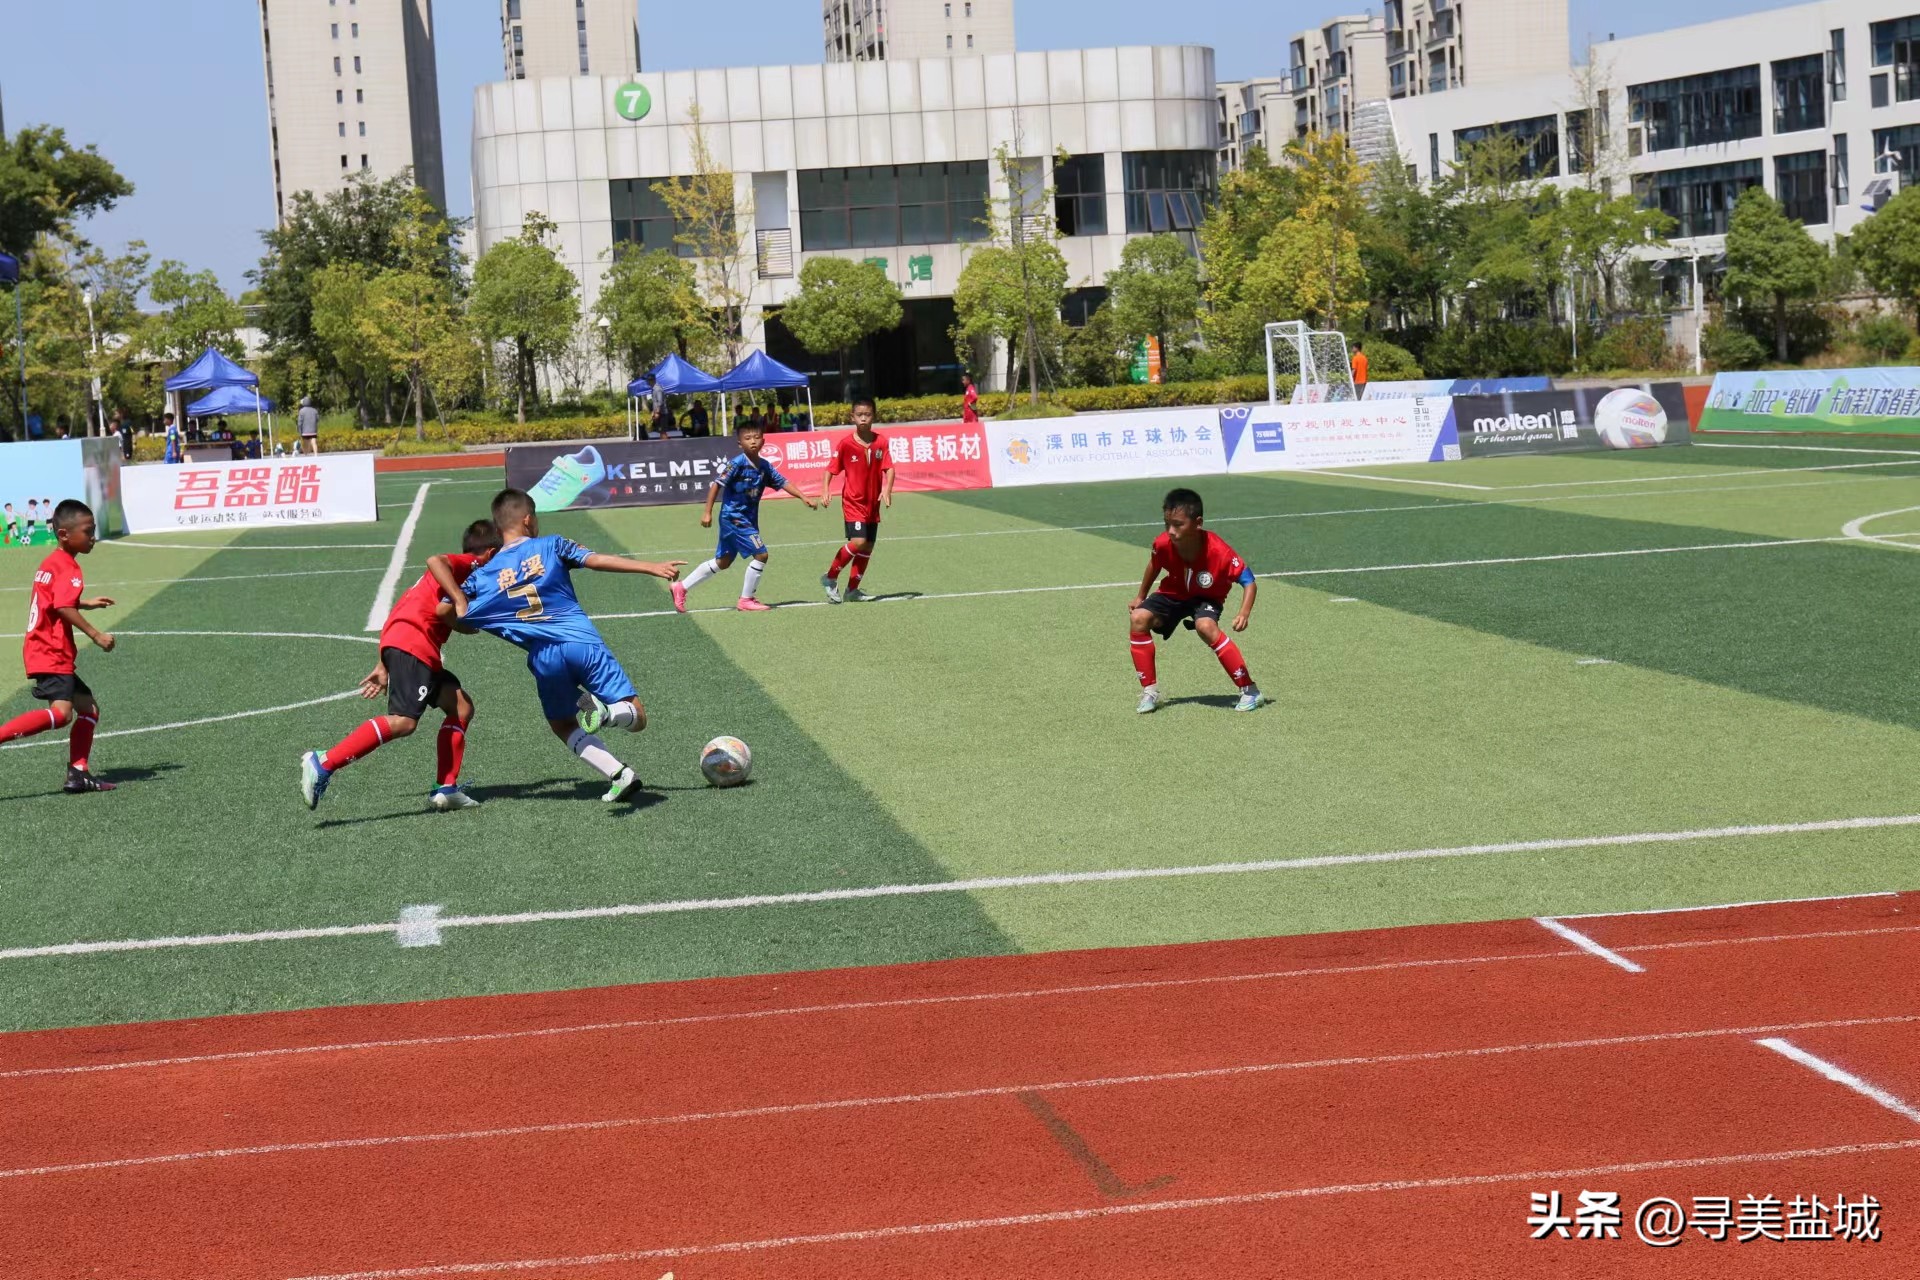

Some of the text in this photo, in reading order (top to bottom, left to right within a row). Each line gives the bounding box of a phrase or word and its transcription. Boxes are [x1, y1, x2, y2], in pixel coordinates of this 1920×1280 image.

[622, 90, 641, 113] 7
[1473, 412, 1552, 433] molten
[1623, 415, 1656, 430] molten
[888, 432, 981, 464] 健康板材
[1046, 425, 1213, 450] 溧阳市足球协会
[1473, 433, 1554, 444] For the real game
[1047, 447, 1213, 465] LIYANG FOOTBALL ASSOCIATION
[606, 458, 711, 481] KELME
[174, 464, 322, 510] 吾器酷
[854, 521, 862, 530] 8
[418, 685, 429, 702] 9
